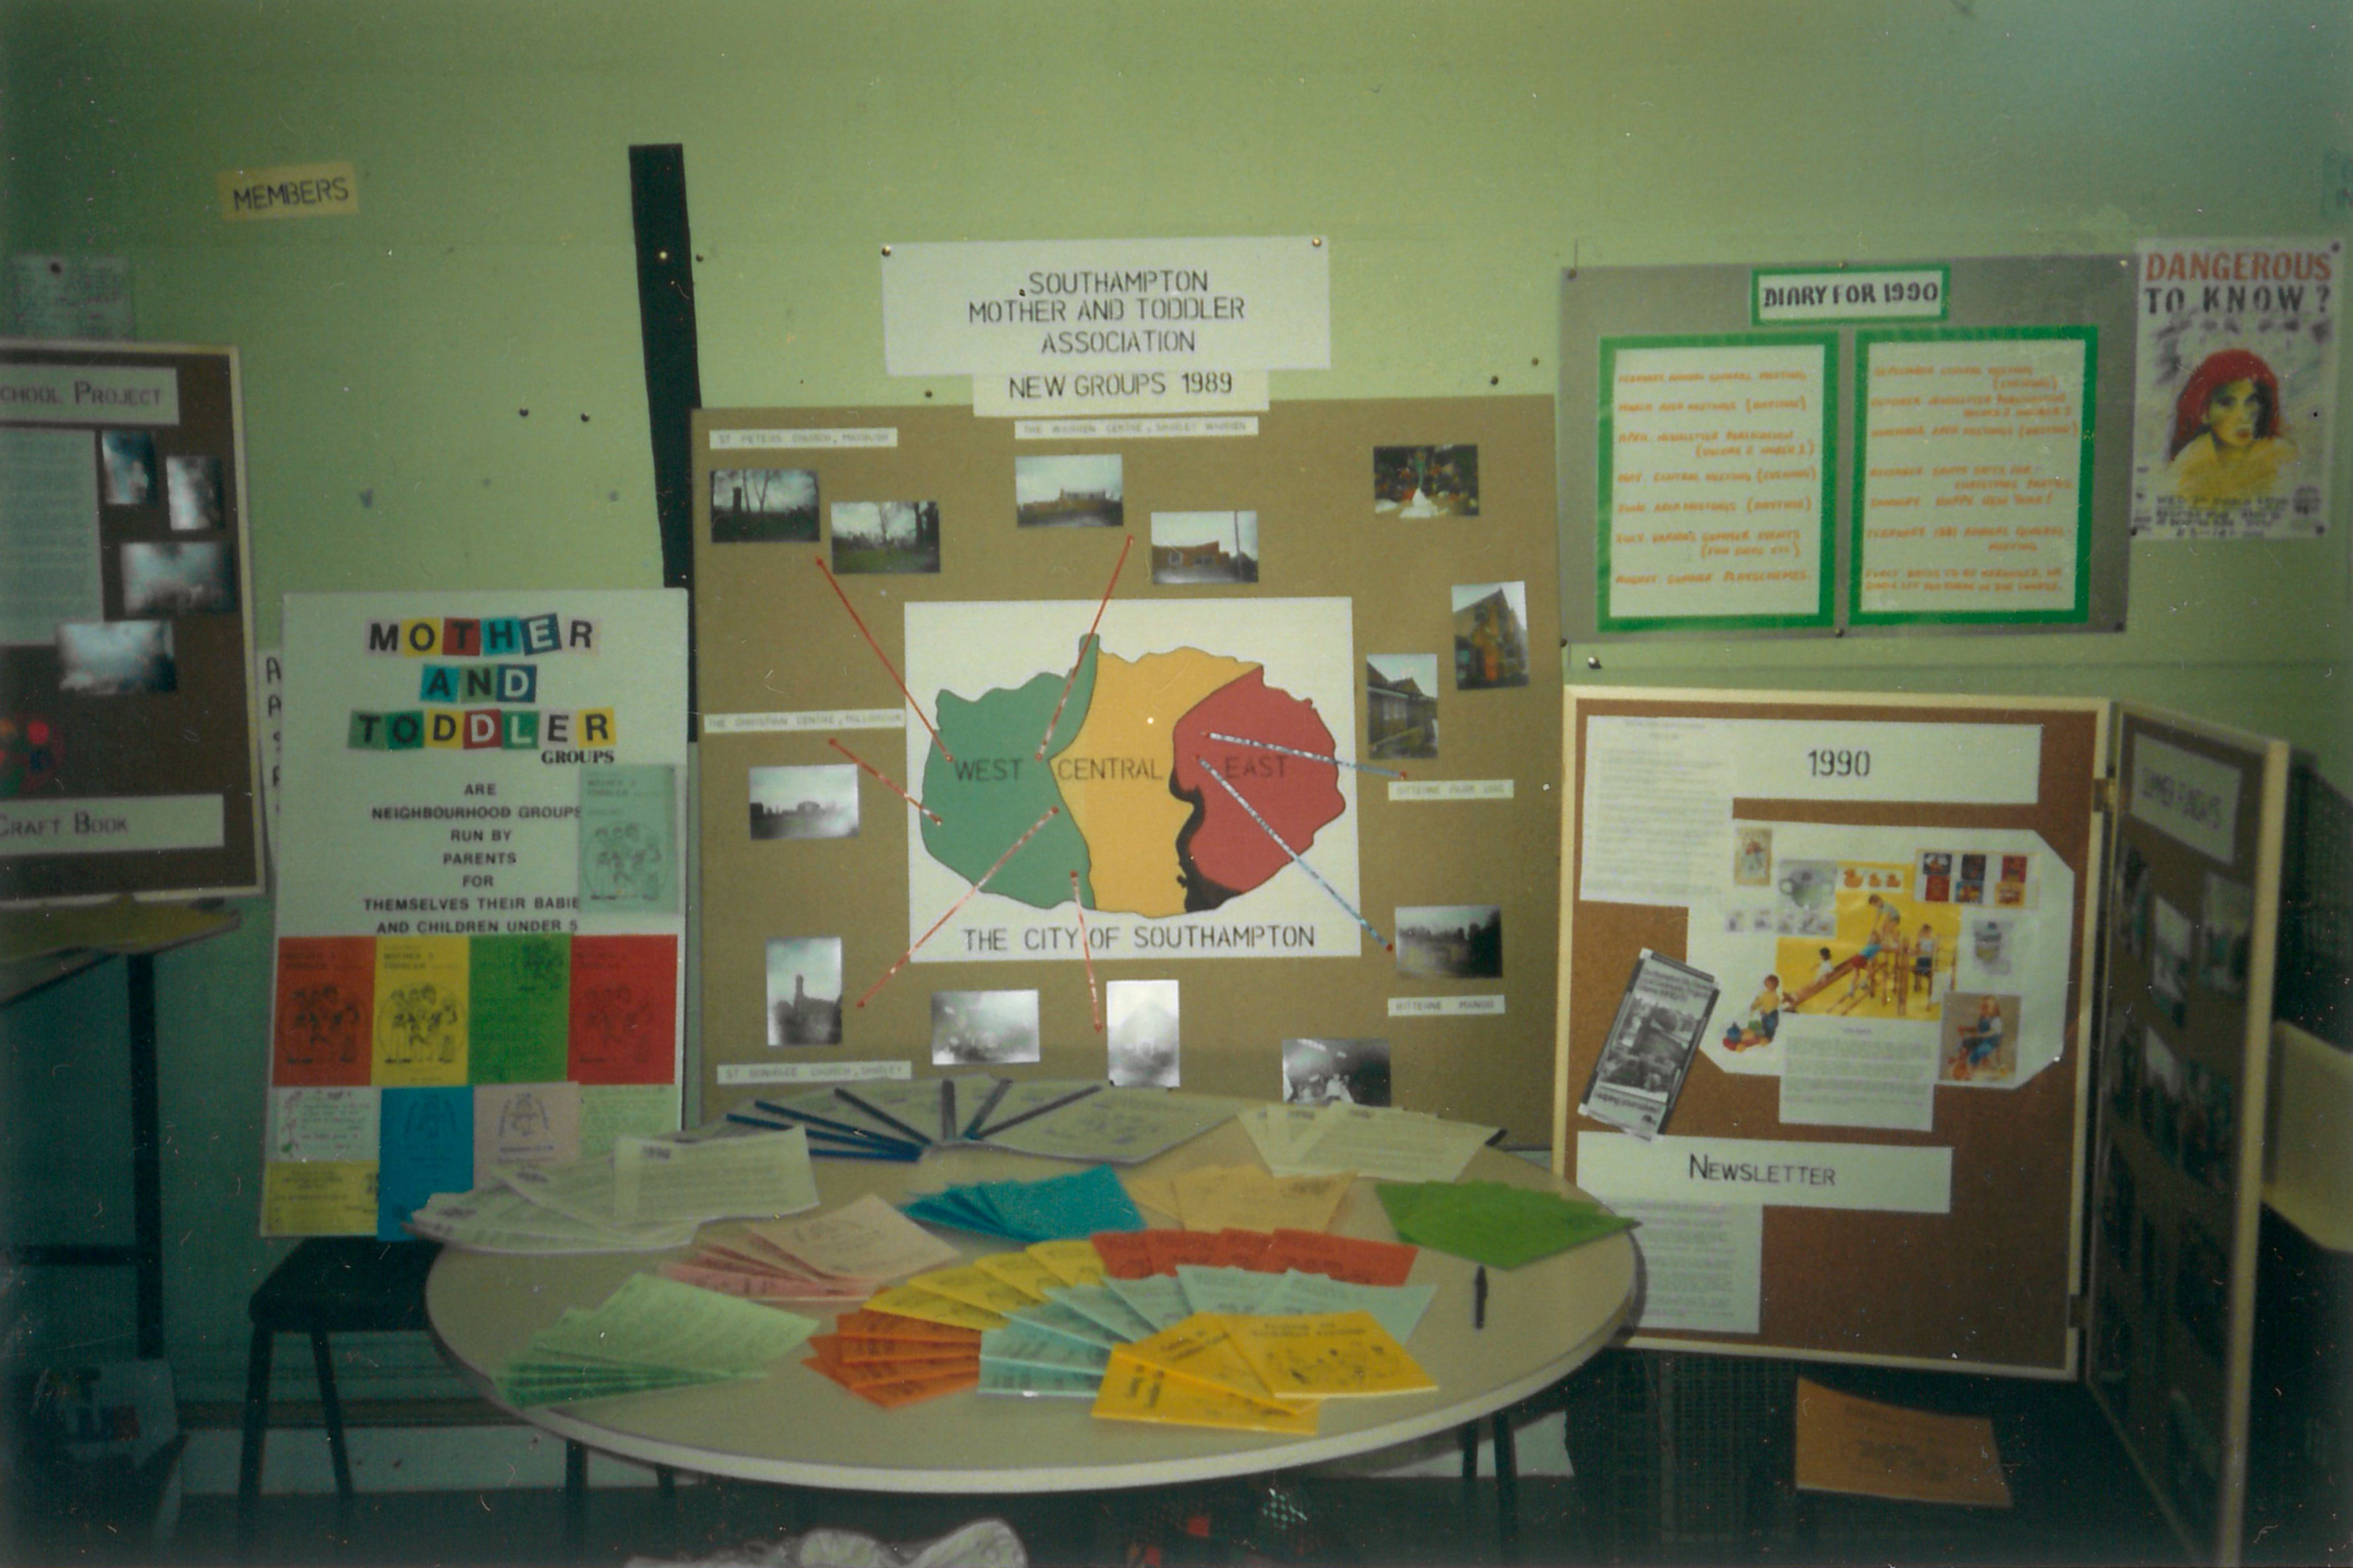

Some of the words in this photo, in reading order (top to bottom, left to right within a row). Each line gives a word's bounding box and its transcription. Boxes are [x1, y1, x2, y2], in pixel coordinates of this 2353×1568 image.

[232, 176, 350, 211] MEMBERS
[2146, 251, 2331, 281] DANGEROUS
[1028, 269, 1209, 296] SOUTHAMPTON
[1764, 285, 1828, 307] DIARY
[1832, 284, 1876, 304] FOR
[1883, 282, 1938, 303] 1990
[969, 300, 1066, 324] MOTHER
[1077, 298, 1125, 321] AND
[1135, 296, 1246, 320] TODDLER
[2144, 287, 2185, 314] TO
[1041, 330, 1196, 354] ASSOCIATION
[1009, 374, 1066, 399] NEW
[1074, 372, 1166, 396] GROUPS
[1181, 370, 1233, 395] 1989
[368, 618, 594, 653] MOTHER
[426, 669, 530, 697] AND
[358, 712, 610, 744] TODDLER
[540, 750, 615, 765] GROUPS
[953, 758, 1022, 780] WEST
[1057, 758, 1164, 780] CENTRAL
[1224, 756, 1287, 780] EAST
[1808, 749, 1871, 778] 1990
[464, 783, 497, 796] ARE
[371, 805, 512, 820] NEIGHBOURHOOD
[450, 830, 484, 842] RUN
[491, 830, 512, 842] BY
[442, 852, 517, 866] PARENTS
[462, 875, 494, 888] FOR
[363, 898, 470, 911] THEMSELVES
[477, 897, 526, 910] THEIR
[376, 921, 410, 934] AND
[416, 920, 499, 934] CHILDREN
[506, 920, 562, 933] UNDER
[964, 928, 1008, 952] THE
[1024, 928, 1079, 951] CITY
[1088, 927, 1119, 949] OF
[1134, 925, 1315, 949] SOUTHAMPTON
